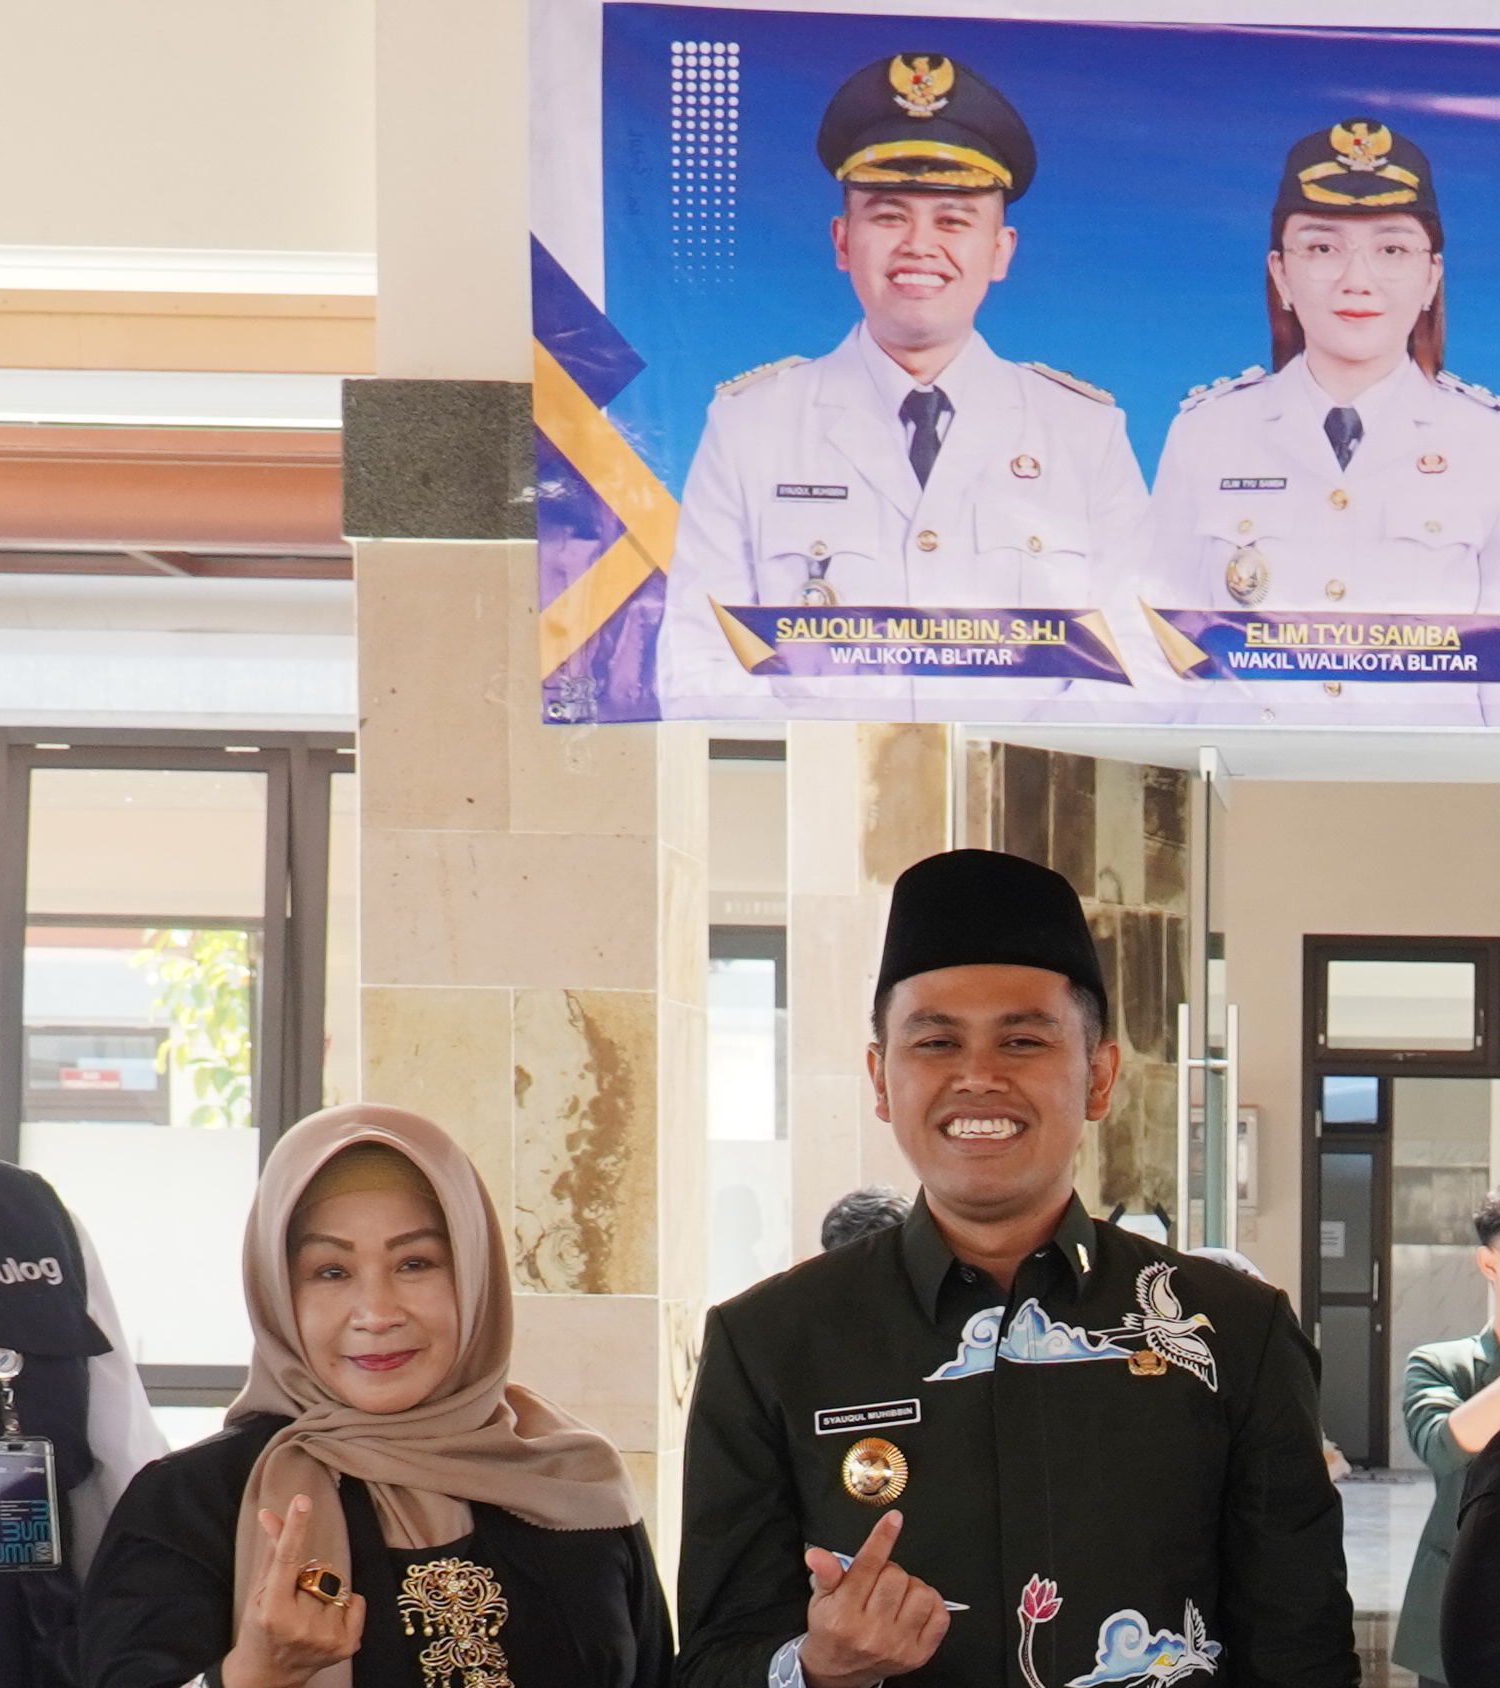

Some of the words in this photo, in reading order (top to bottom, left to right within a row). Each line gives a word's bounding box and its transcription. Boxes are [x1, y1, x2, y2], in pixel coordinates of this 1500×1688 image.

[775, 617, 882, 641] SAUQUL
[886, 618, 1005, 644] MUHIBIN,
[1010, 619, 1065, 642] S.H.I
[1245, 622, 1309, 646] ELIM
[1312, 623, 1364, 647] TYU
[1368, 624, 1461, 648] SAMBA
[830, 646, 941, 666] WALIKOTA
[942, 647, 1013, 667] BLITAR
[1228, 651, 1295, 670] WAKIL
[1297, 651, 1404, 671] WALIKOTA
[1407, 652, 1478, 672] BLITAR
[823, 1413, 866, 1425] SYAUQUL
